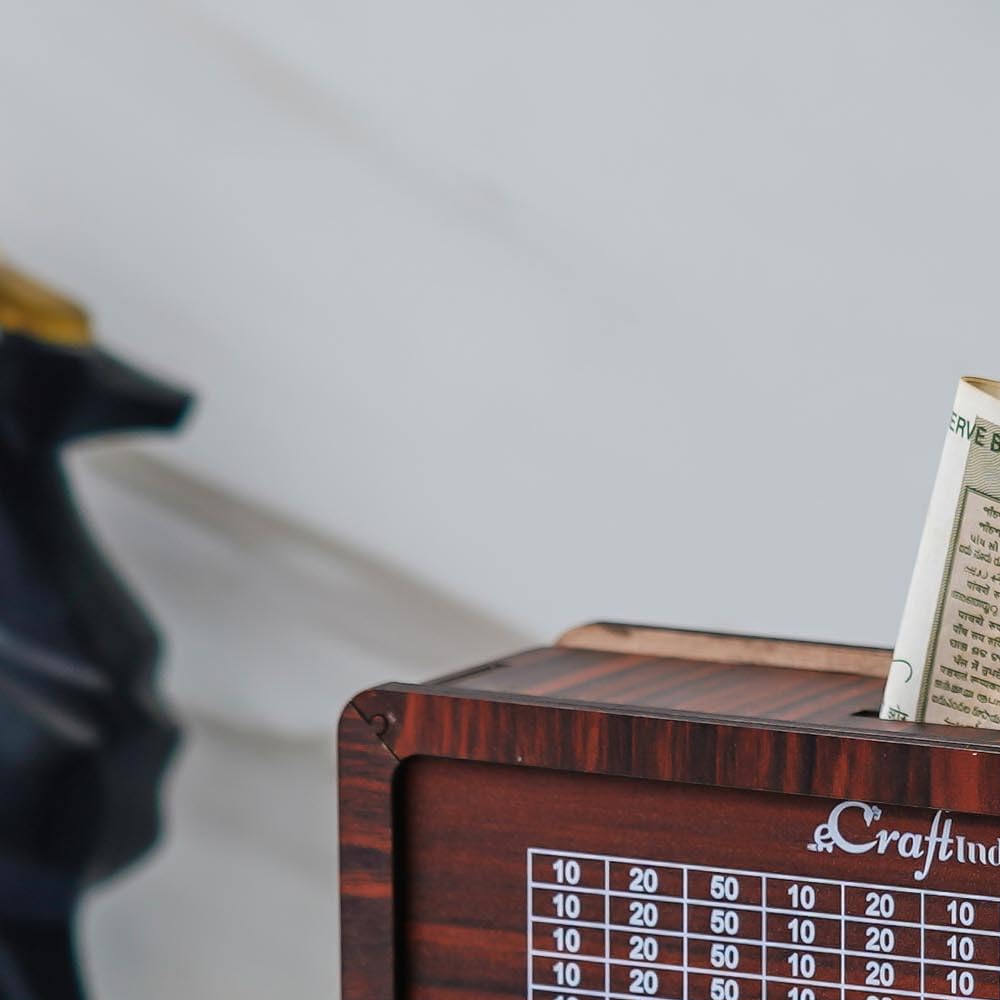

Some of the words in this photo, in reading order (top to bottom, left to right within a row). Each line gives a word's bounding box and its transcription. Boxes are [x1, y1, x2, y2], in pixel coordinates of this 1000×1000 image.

[552, 858, 581, 885] 10
[628, 866, 659, 893] 20
[710, 874, 740, 901] 50
[787, 883, 816, 910] 10
[865, 891, 895, 919] 20
[947, 899, 975, 927] 10
[552, 927, 581, 953] 10
[629, 935, 659, 962] 20
[710, 943, 740, 970] 50
[787, 952, 816, 979] 10
[865, 960, 895, 987] 20
[946, 969, 975, 996] 10
